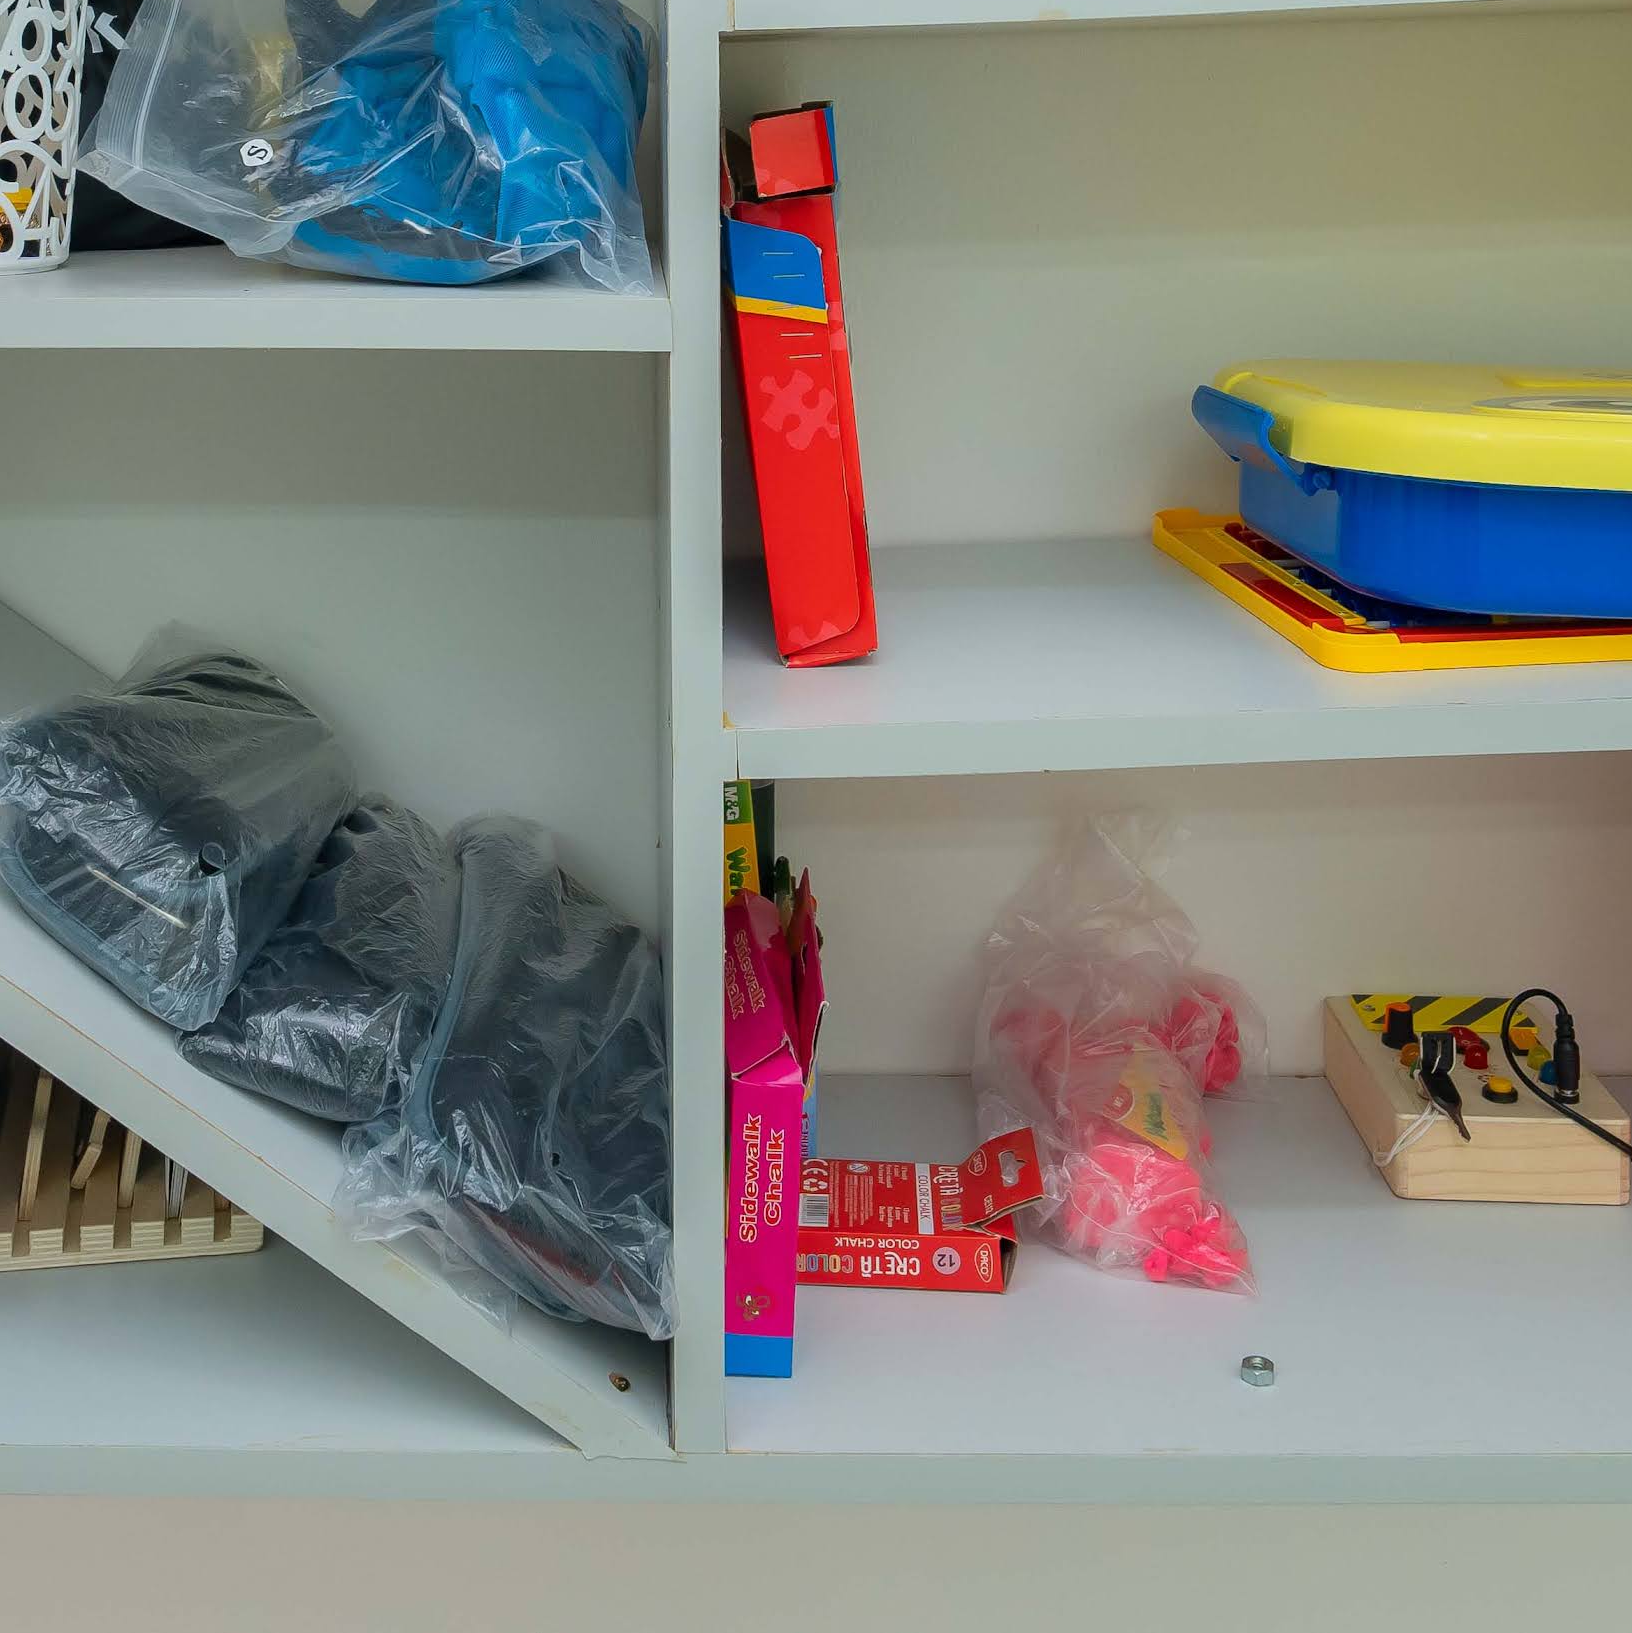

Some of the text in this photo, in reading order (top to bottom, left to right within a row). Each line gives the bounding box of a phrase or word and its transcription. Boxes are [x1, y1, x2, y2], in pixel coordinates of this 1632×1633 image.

[247, 145, 269, 161] S
[724, 955, 745, 1020] Chalk
[733, 929, 766, 1014] Sidewalk
[738, 1112, 762, 1242] Sidewalk
[763, 1128, 785, 1226] Chalk
[918, 1175, 931, 1220] COLOR CHALK
[834, 1237, 920, 1249] COLOR CHALK
[937, 1253, 956, 1268] 12
[796, 1253, 854, 1273] COLOR
[979, 1250, 989, 1275] DACO
